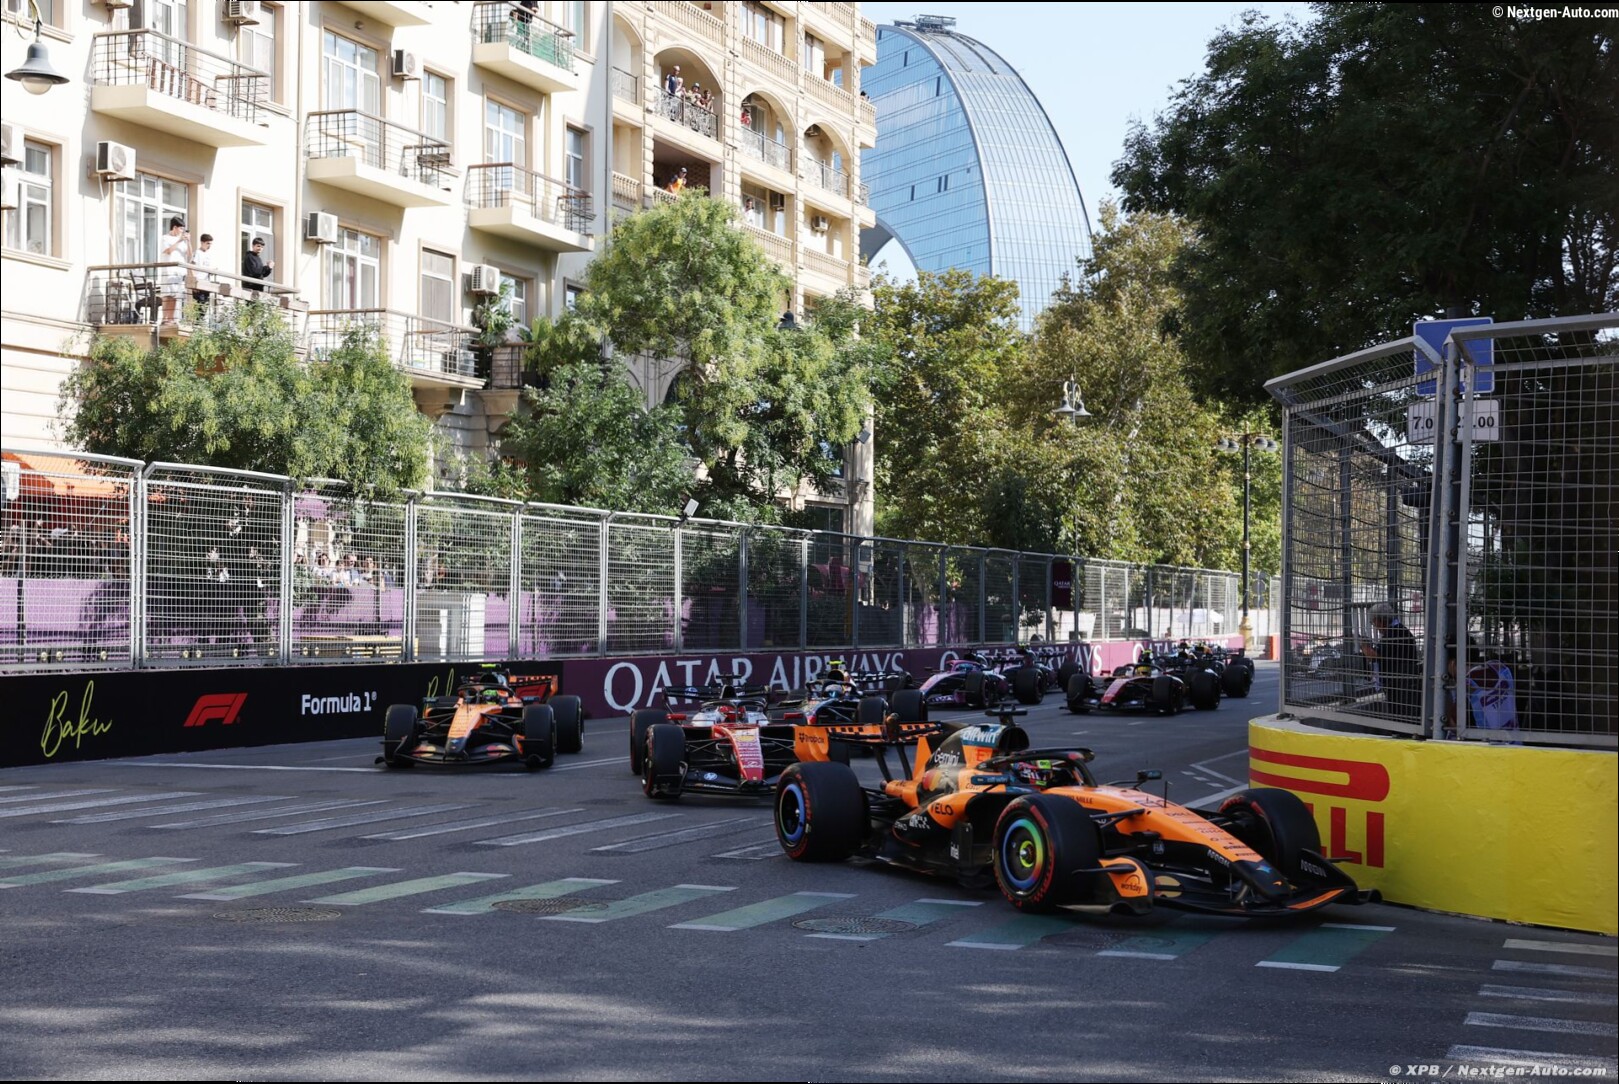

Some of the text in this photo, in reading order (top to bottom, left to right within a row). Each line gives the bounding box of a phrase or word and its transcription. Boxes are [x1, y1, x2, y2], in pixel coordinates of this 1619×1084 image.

[301, 692, 361, 716] Formula
[40, 680, 113, 758] Baku
[934, 747, 961, 767] Gemini
